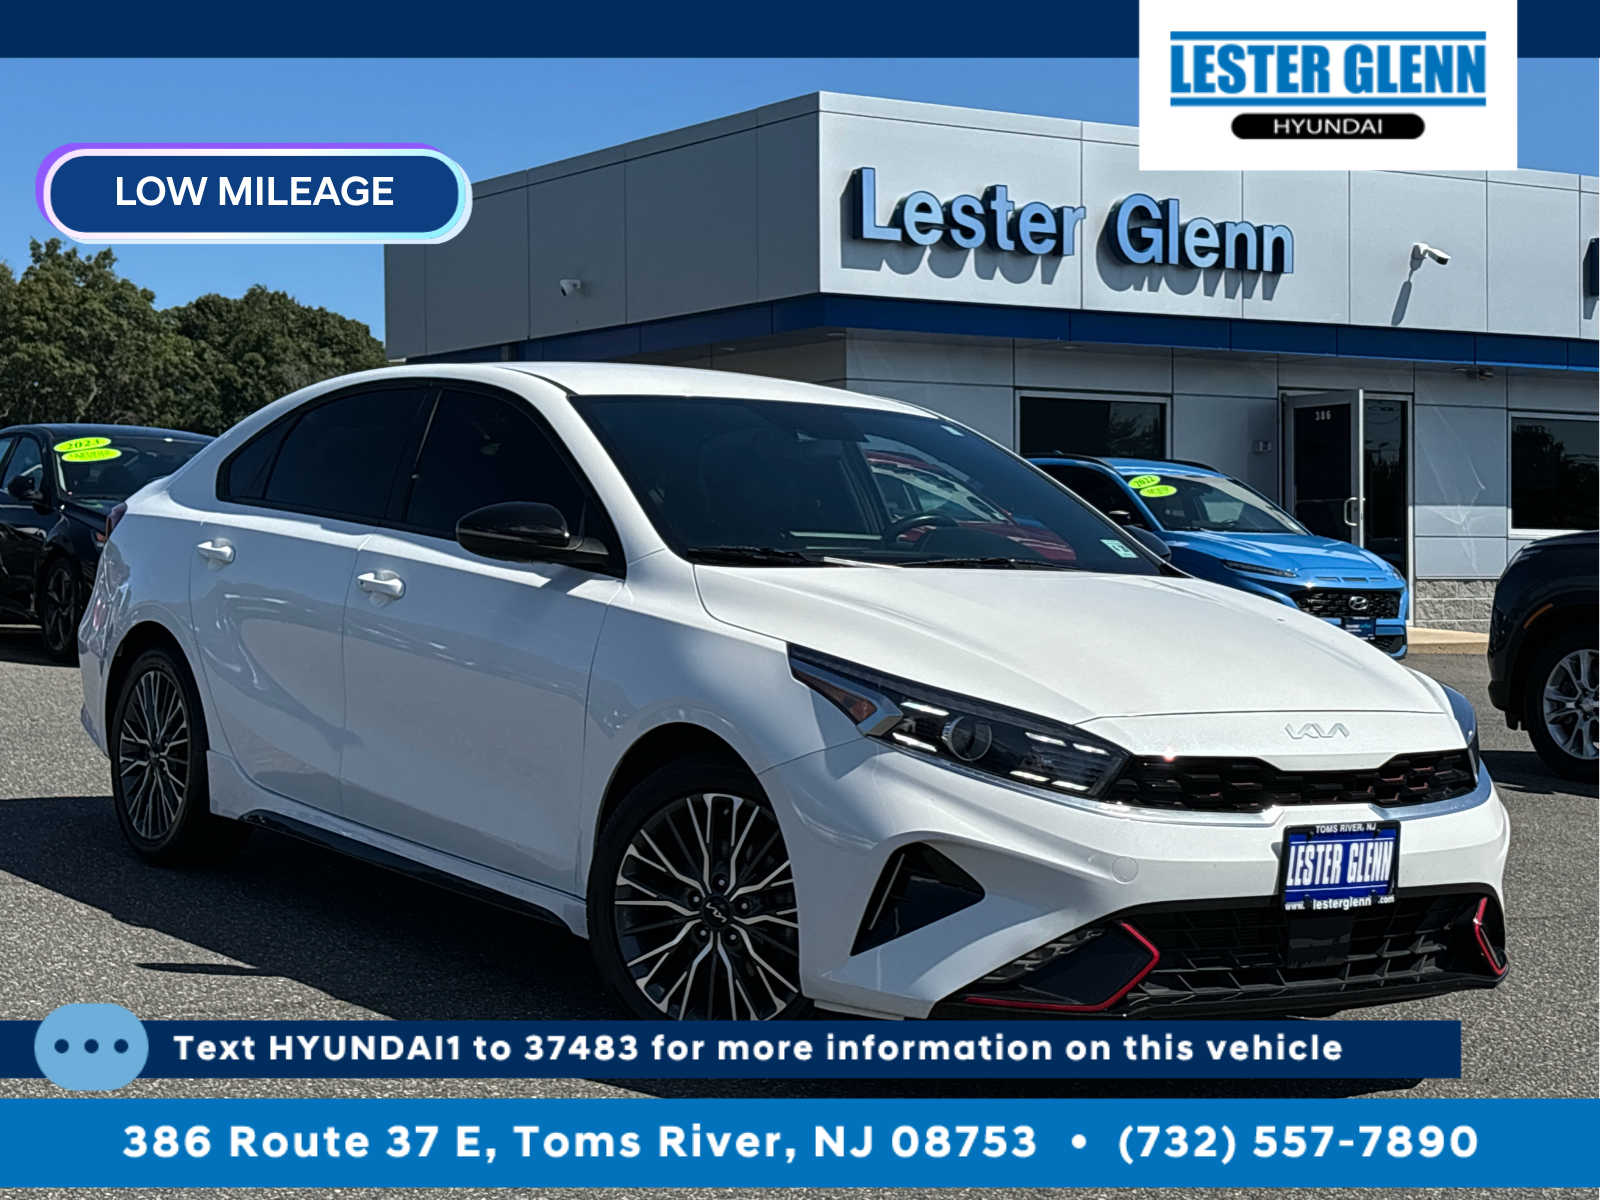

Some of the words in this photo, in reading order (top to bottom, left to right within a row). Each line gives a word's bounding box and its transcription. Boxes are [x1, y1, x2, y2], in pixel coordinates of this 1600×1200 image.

[853, 166, 1086, 258] Lester
[1112, 192, 1295, 274] Glenn
[1315, 824, 1338, 834] TOMS
[1366, 822, 1377, 831] NJ
[1286, 843, 1344, 887] LESTER
[1347, 840, 1394, 884] GLENN
[1312, 896, 1372, 911] lesterglenn
